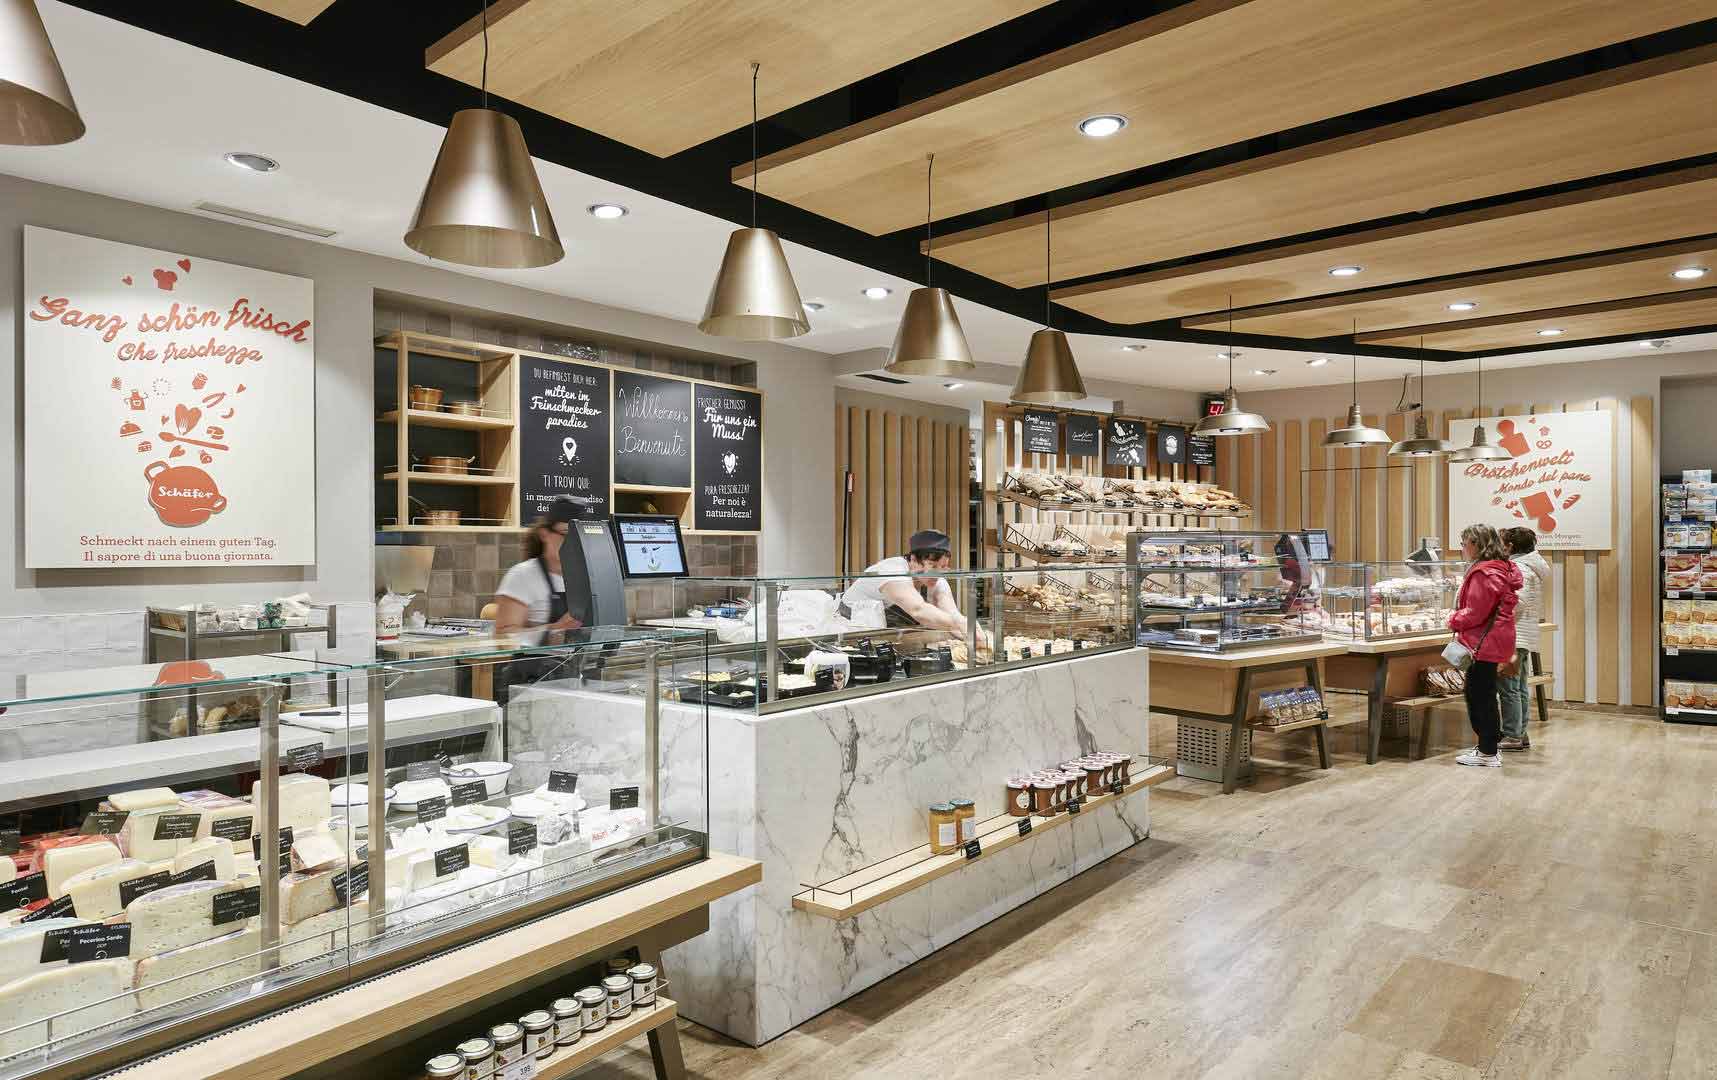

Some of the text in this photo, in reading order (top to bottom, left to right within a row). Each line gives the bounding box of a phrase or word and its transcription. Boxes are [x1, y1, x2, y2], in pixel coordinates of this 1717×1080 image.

[30, 295, 311, 342] Ganz schön frisch
[116, 337, 263, 364] Che freschezza
[545, 385, 590, 401] mitten im
[546, 414, 588, 430] paradies
[703, 407, 757, 427] Für uns ein
[712, 423, 746, 440] Muss!
[1464, 449, 1574, 478] Brötchenwelt
[543, 474, 551, 487] TI
[554, 475, 576, 489] TROVI
[1494, 470, 1592, 494] Mondo del pane
[158, 486, 213, 498] Schäfer
[526, 493, 535, 501] in
[713, 495, 746, 506] Per noi è
[705, 508, 752, 518] naturalezza!
[80, 535, 277, 548] Schmeckt nach einem guten Tag.
[84, 551, 273, 563] Il sapore di una buona giornata.
[80, 934, 124, 944] Pecorino Sardo
